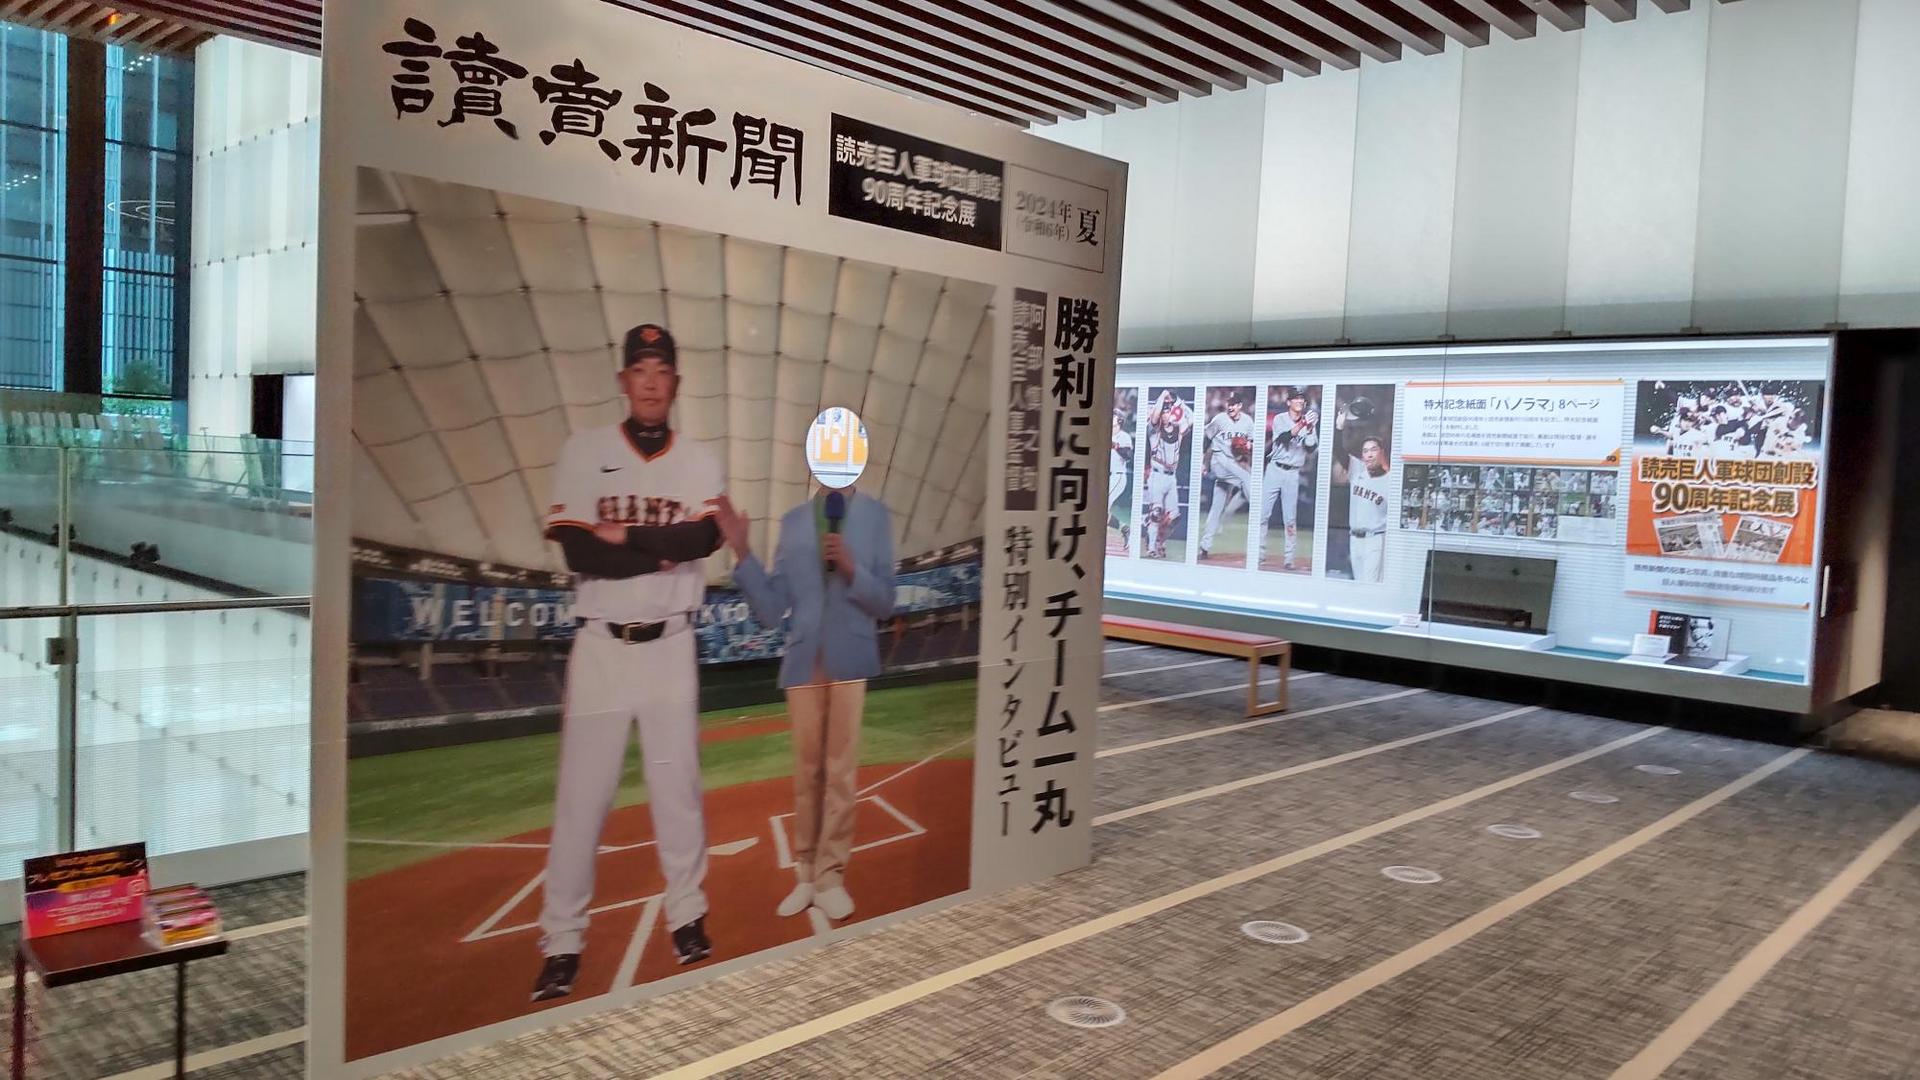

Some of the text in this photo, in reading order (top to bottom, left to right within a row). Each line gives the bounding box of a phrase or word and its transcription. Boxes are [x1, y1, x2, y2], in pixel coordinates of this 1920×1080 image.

[836, 133, 1002, 202] 読売巨人軍球団創設
[861, 177, 977, 228] 90周年記念展
[1015, 190, 1072, 224] 2024年
[1076, 207, 1101, 246] 夏
[1640, 457, 1817, 487] 読売巨人軍球団創設
[1654, 483, 1798, 514] 90周年記念展
[1030, 296, 1099, 834] 勝利に向け、チーム一丸
[411, 597, 577, 628] WELCOM
[998, 525, 1034, 836] 特別インタビュー
